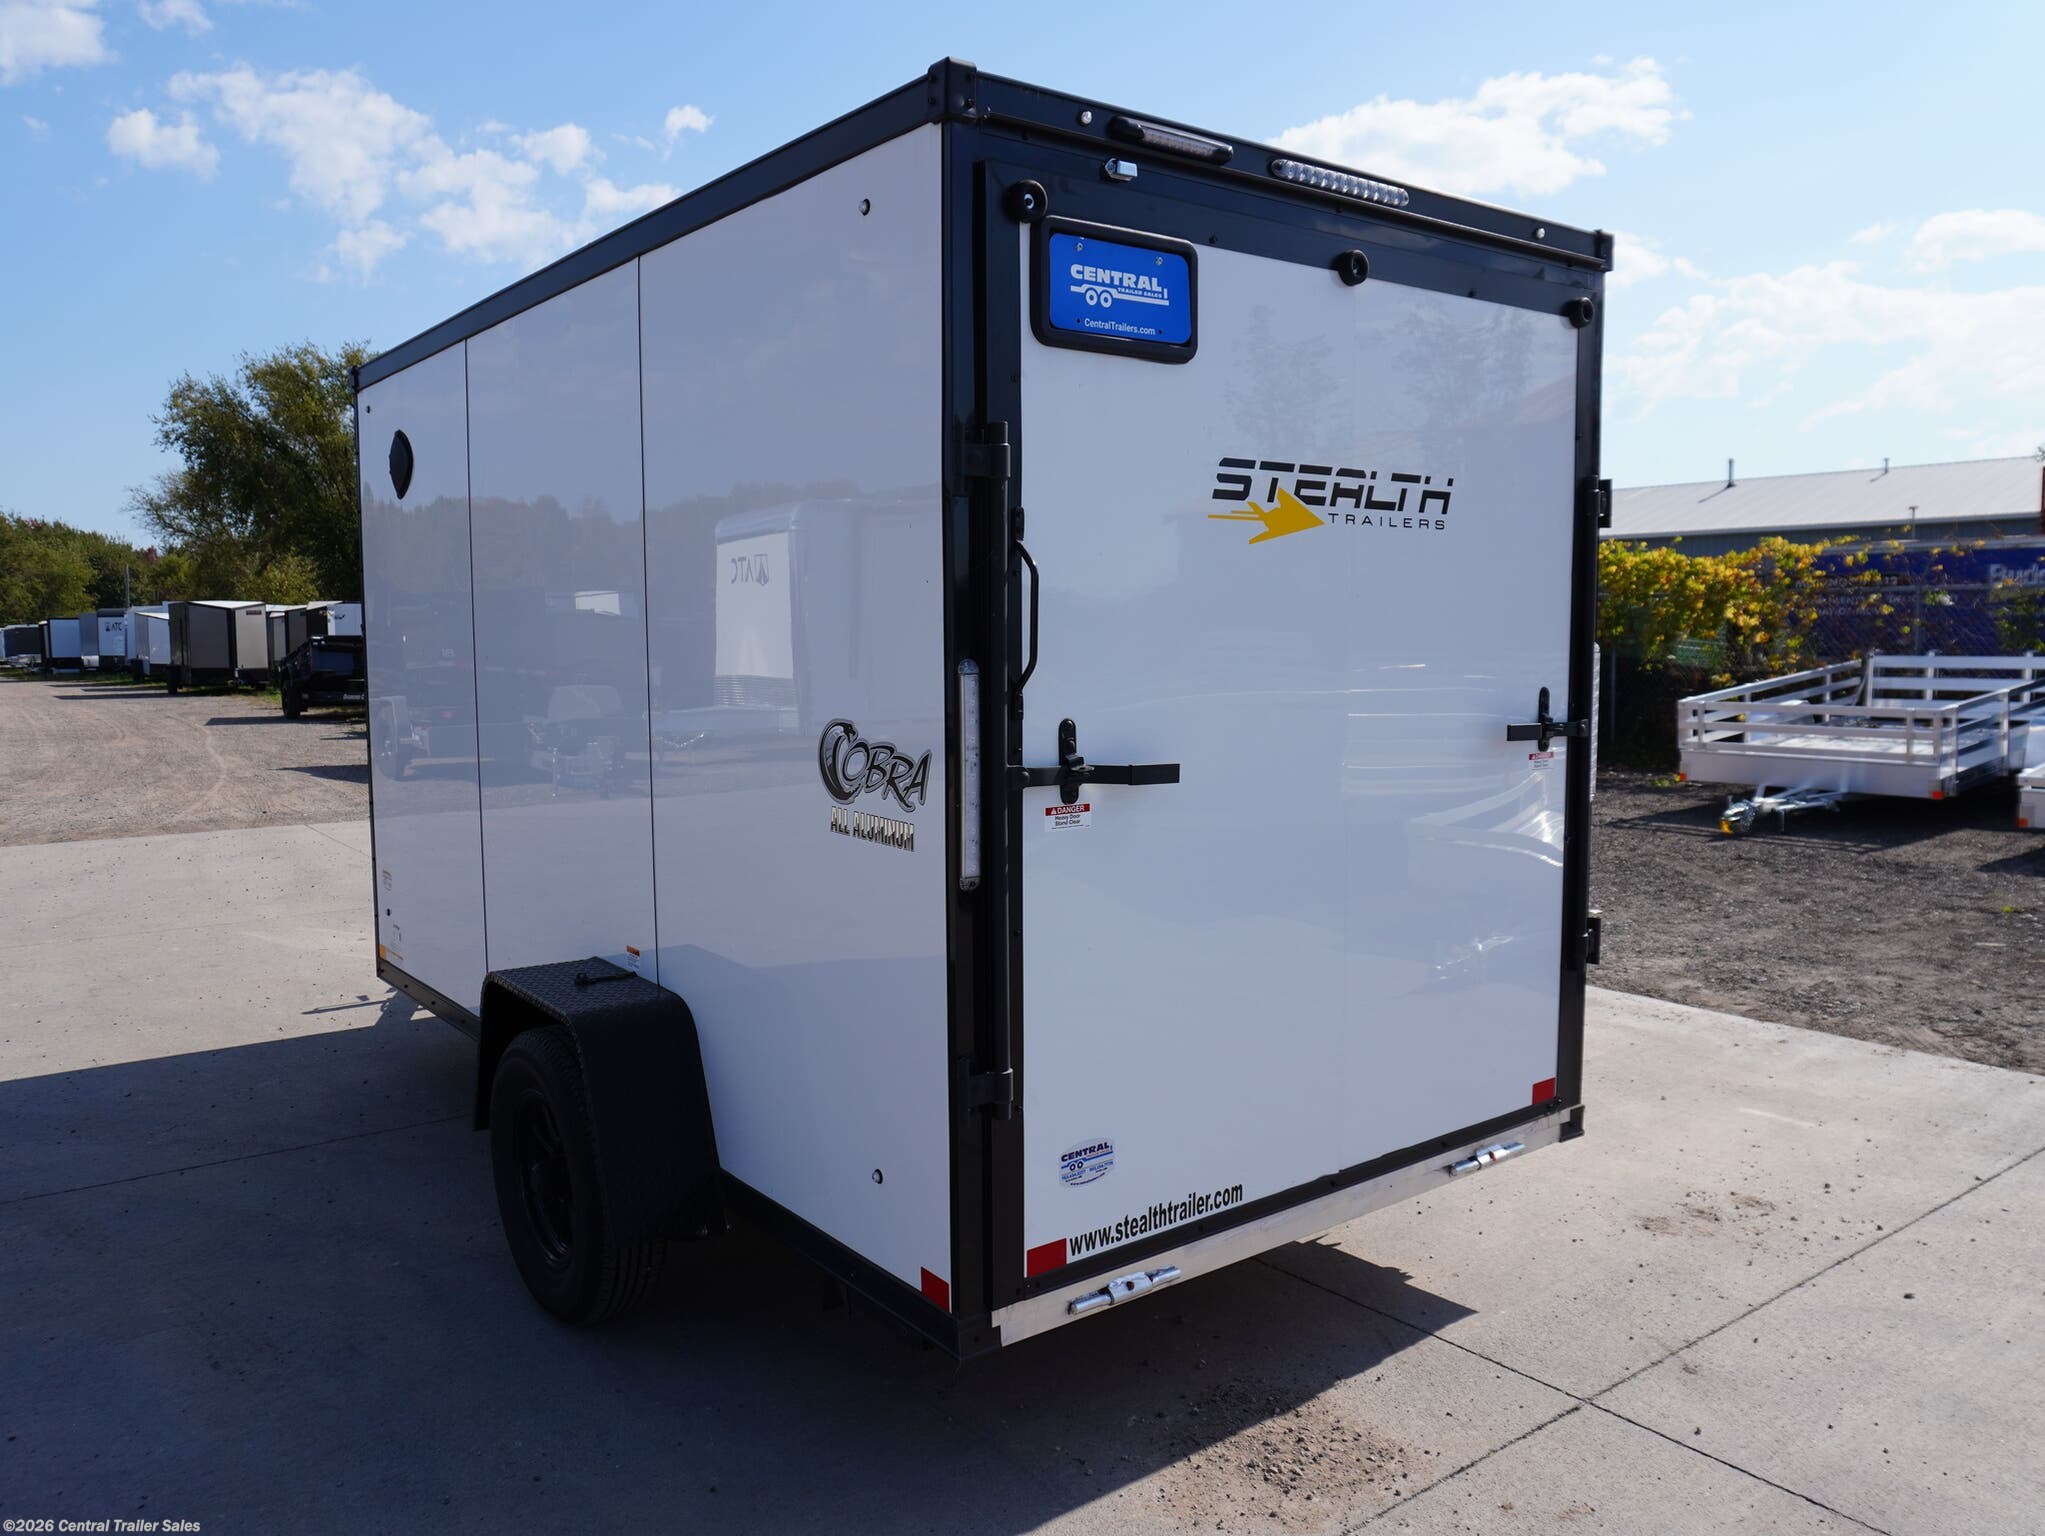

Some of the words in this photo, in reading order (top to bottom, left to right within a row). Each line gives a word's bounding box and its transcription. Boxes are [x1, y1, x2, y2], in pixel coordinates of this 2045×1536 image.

[1070, 263, 1163, 292] CENTRAL
[1117, 287, 1143, 296] TRAILER
[1143, 290, 1163, 299] SALES
[1084, 317, 1156, 336] CentralTrailers.com
[1211, 457, 1455, 515] STEALTH
[1328, 512, 1447, 530] TRAILERS
[1057, 804, 1085, 814] DANGER
[830, 805, 850, 836] ALL
[852, 810, 915, 852] ALUMINUM
[1061, 1142, 1110, 1162] CENTRAL
[1069, 1183, 1243, 1257] www.stealthtrailer.com
